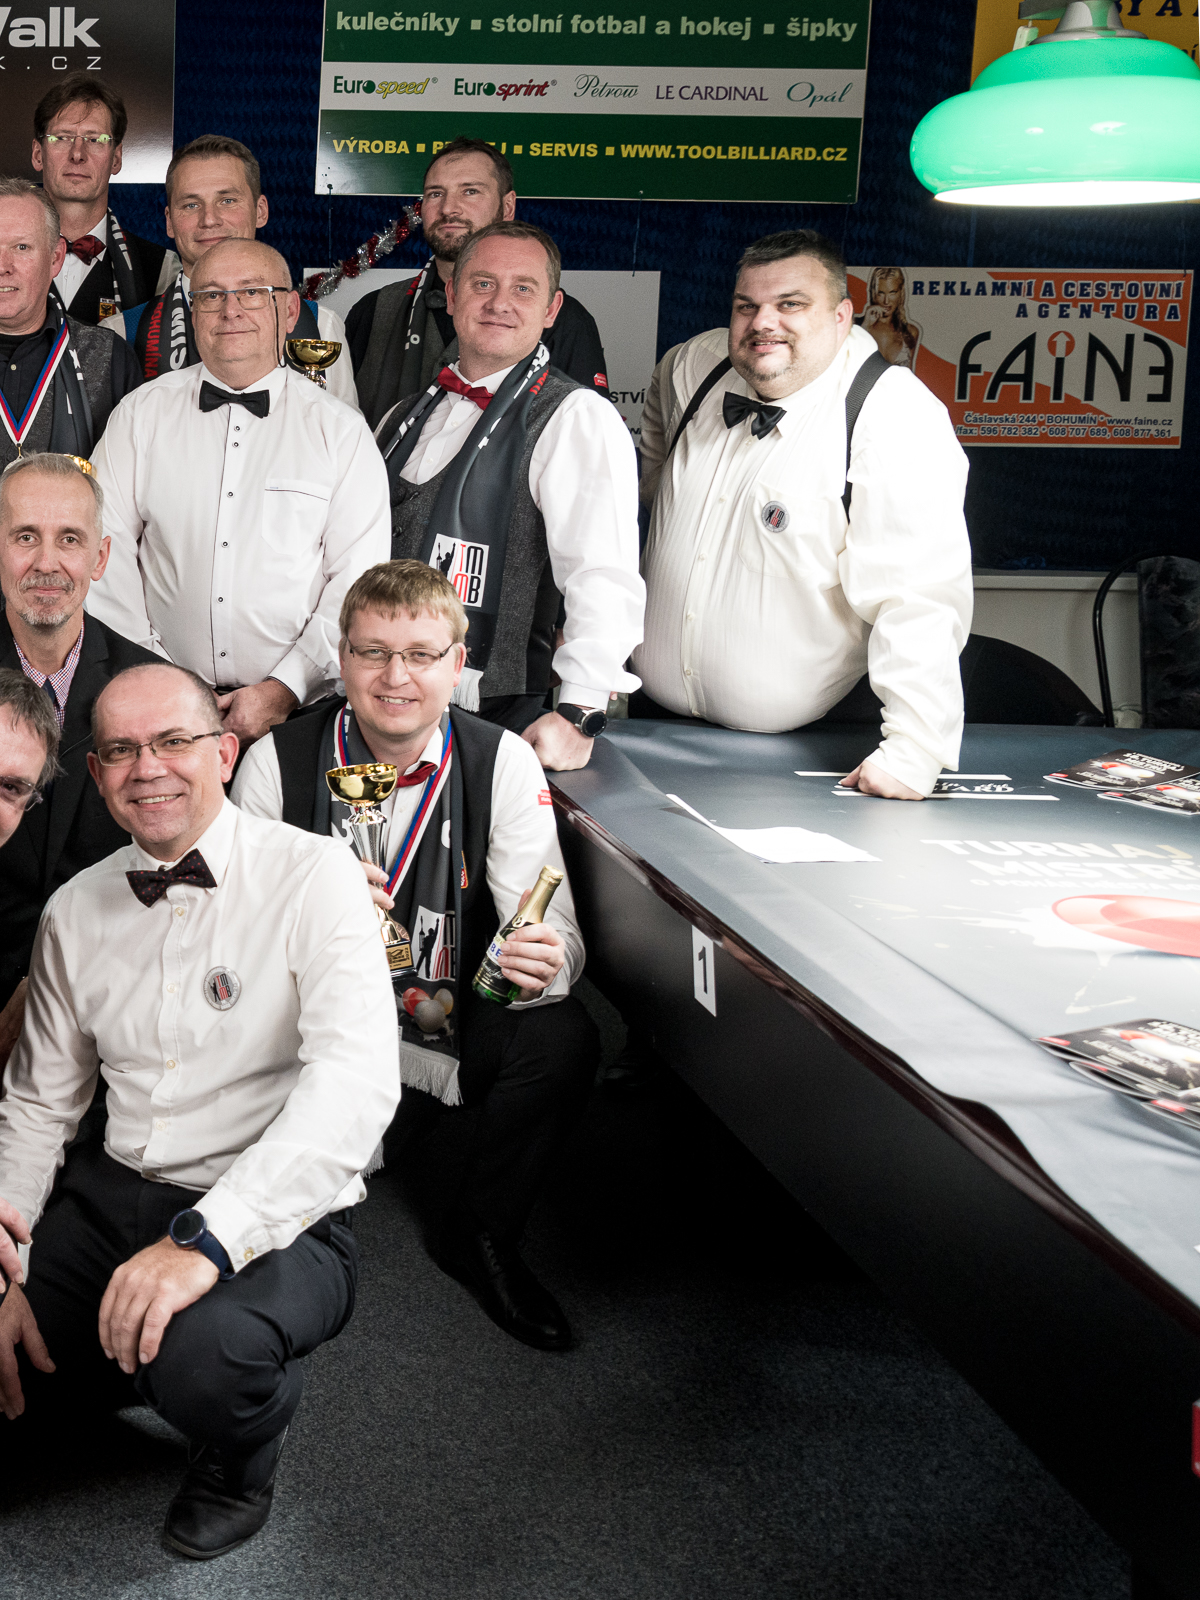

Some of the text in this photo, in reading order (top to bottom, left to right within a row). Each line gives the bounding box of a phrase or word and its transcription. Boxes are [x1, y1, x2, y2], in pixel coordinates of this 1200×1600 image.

[336, 11, 858, 42] kulečníky stolní fotbal a hokej šipky
[573, 73, 639, 98] Petrow
[655, 85, 675, 100] LE
[678, 85, 769, 101] CARDINAL
[786, 81, 854, 108] Opál
[332, 136, 410, 155] VÝROBA
[529, 142, 598, 157] SERVIS
[621, 144, 848, 162] WWW.TOOLBILLIARD.CZ
[912, 279, 1184, 300] REKLAMNÍ A CESTOVNÍ
[1015, 303, 1181, 322] AGENTURA
[964, 412, 1174, 428] Čáslavská 244 BOHUMÍN www.faine.cz
[980, 426, 999, 437] 596
[1000, 427, 1019, 437] 782
[1020, 427, 1040, 437] 382
[1049, 427, 1068, 437] 608
[1069, 427, 1088, 438] 707
[1112, 428, 1132, 438] 608
[1133, 428, 1152, 439] 877
[1153, 429, 1172, 439] 361
[919, 839, 1193, 860] TURNAJ
[698, 945, 708, 995] 1
